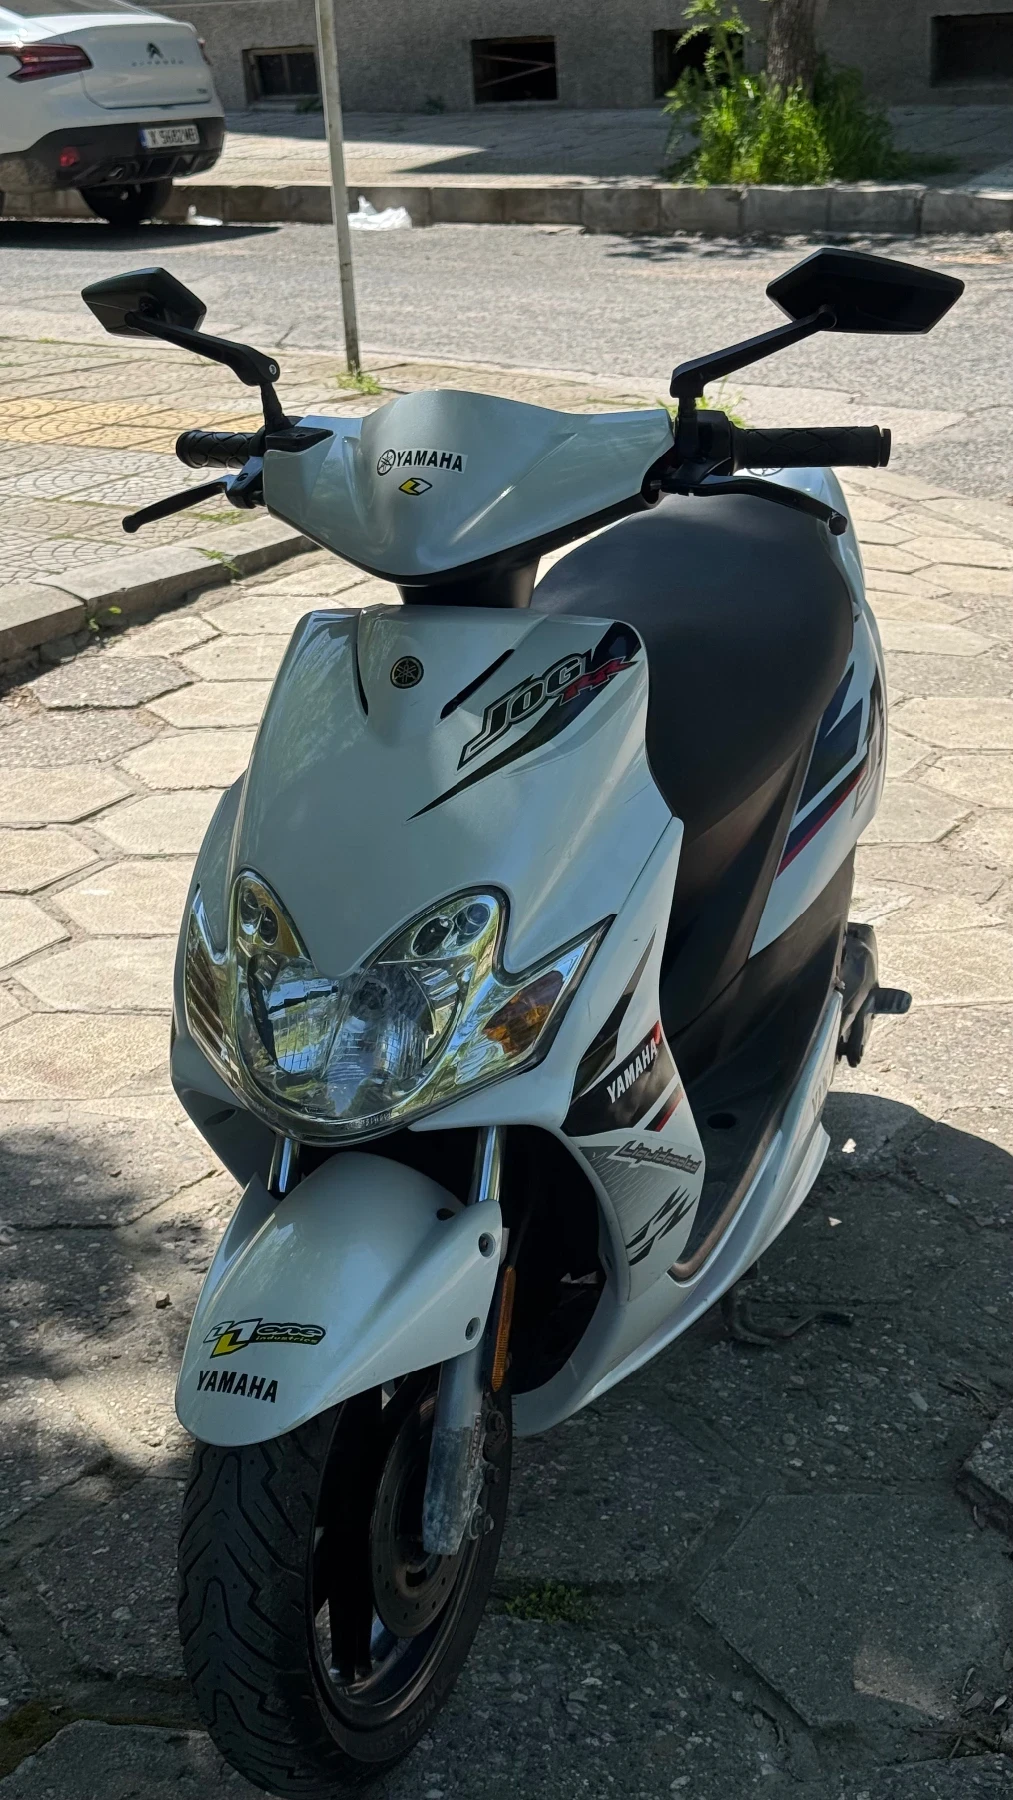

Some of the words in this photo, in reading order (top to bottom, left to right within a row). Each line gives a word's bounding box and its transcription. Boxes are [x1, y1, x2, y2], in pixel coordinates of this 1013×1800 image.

[396, 450, 463, 472] YAMAHA
[457, 648, 593, 771] JOG
[606, 1038, 658, 1104] YAMAHA
[197, 1370, 278, 1404] YAMAHA
